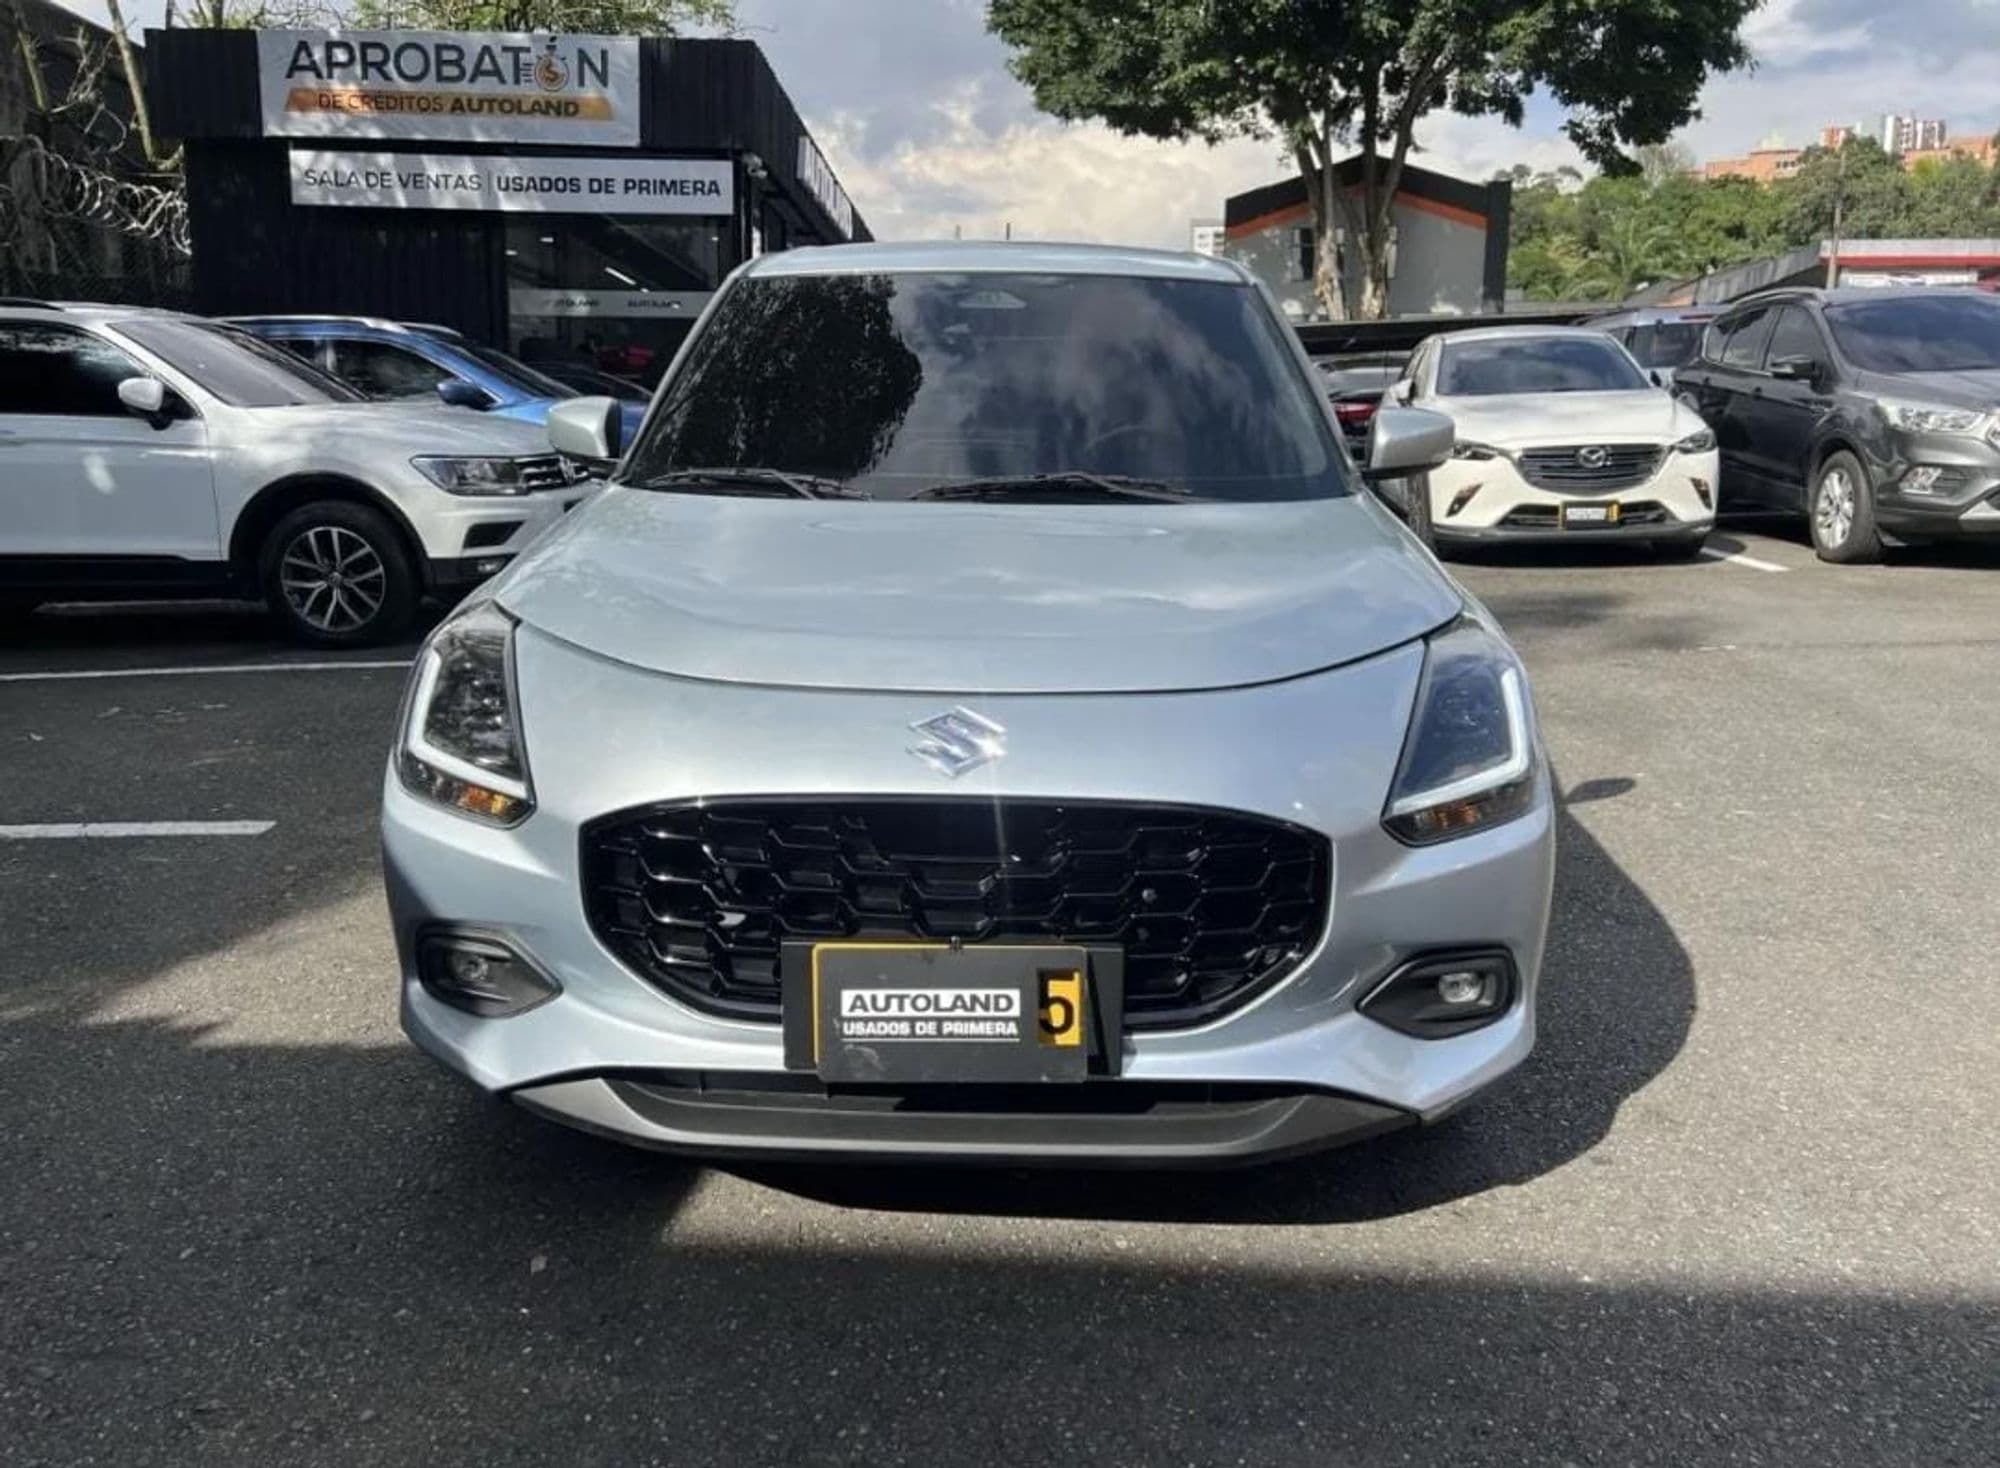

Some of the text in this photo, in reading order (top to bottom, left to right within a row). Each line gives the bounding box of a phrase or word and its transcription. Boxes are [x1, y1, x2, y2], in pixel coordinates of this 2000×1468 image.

[318, 92, 344, 109] DE
[450, 96, 580, 118] AUTOLAND
[304, 170, 721, 197] SALA DE VENTAS USADOS DE PRIMERA
[850, 993, 1013, 1013] AUTOLAND
[842, 1022, 1018, 1036] USADOS DE PRIMERA
